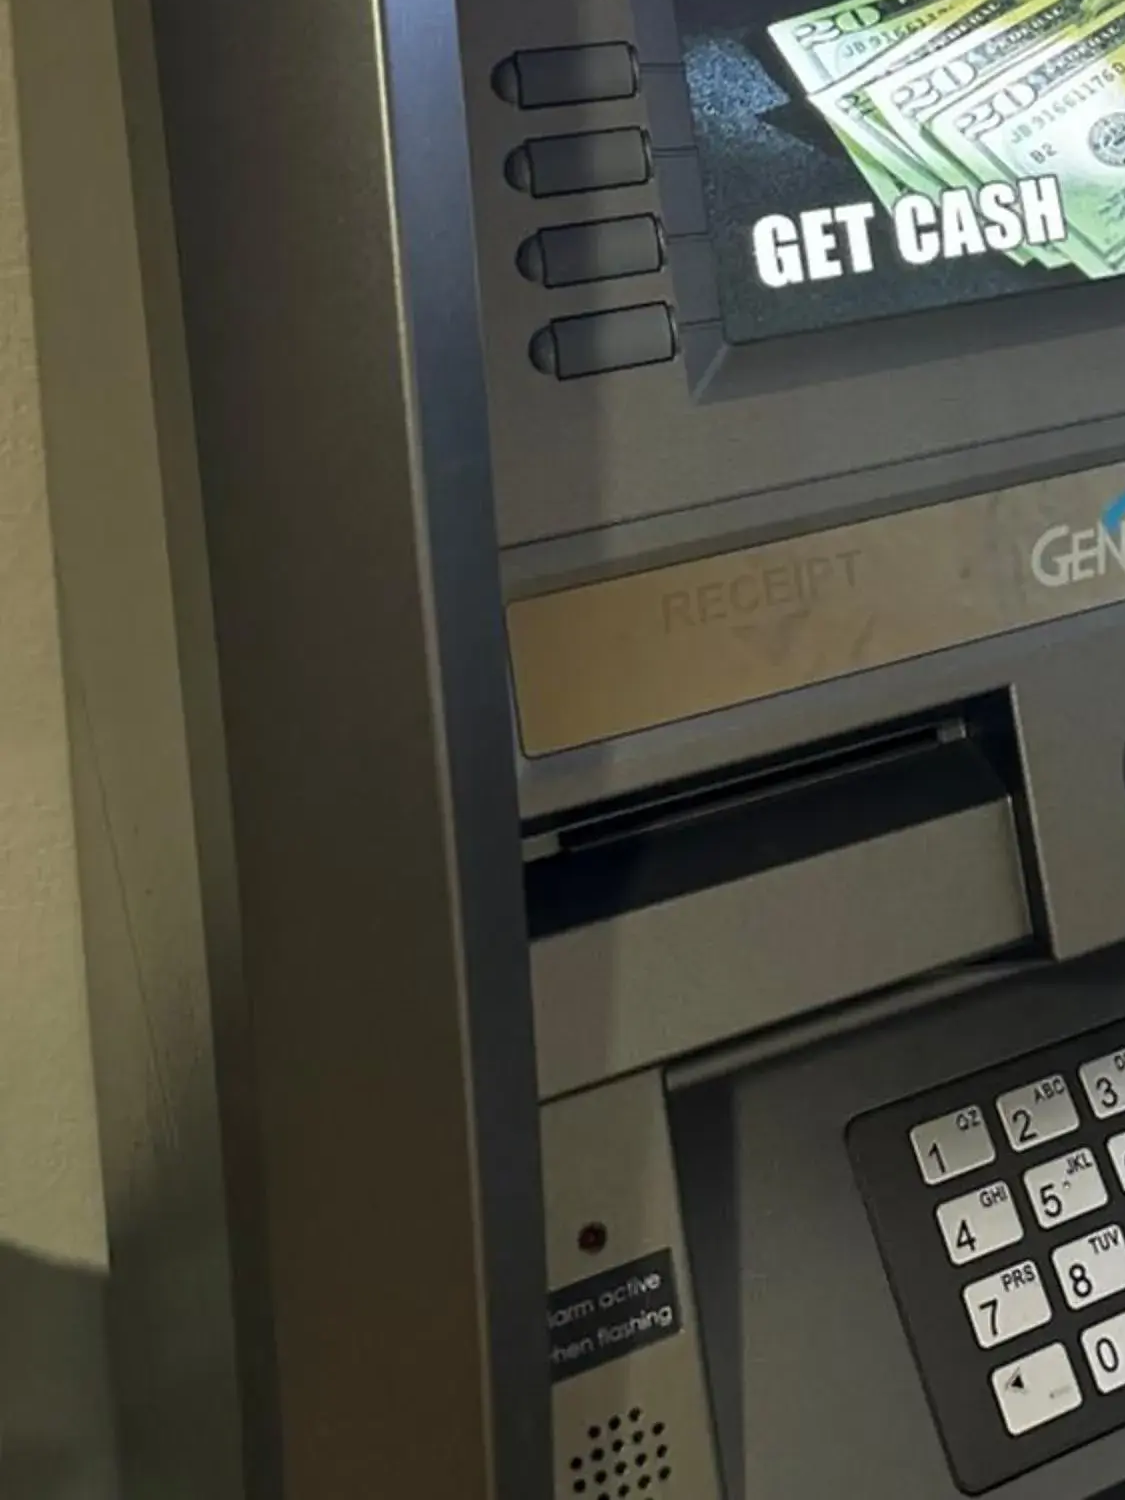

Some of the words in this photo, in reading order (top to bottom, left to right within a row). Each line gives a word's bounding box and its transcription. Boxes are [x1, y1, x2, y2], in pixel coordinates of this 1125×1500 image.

[752, 202, 875, 288] GET
[892, 173, 1068, 265] CASH
[661, 549, 862, 635] RECEIPT
[1033, 1078, 1065, 1105] ABC
[1095, 1077, 1119, 1108] 3
[1012, 1108, 1037, 1143] 2
[928, 1142, 947, 1174] 1
[1065, 1153, 1093, 1176] JKL
[979, 1185, 1010, 1208] GHI
[1039, 1182, 1063, 1218] 5
[956, 1219, 977, 1251] 4
[1088, 1228, 1120, 1255] TUV
[598, 1273, 661, 1309] active
[1001, 1264, 1036, 1293] PRS
[1069, 1263, 1093, 1298] 8
[550, 1337, 595, 1365] hen
[597, 1305, 673, 1347] flashing
[979, 1298, 999, 1337] 7
[1096, 1337, 1120, 1373] 0
